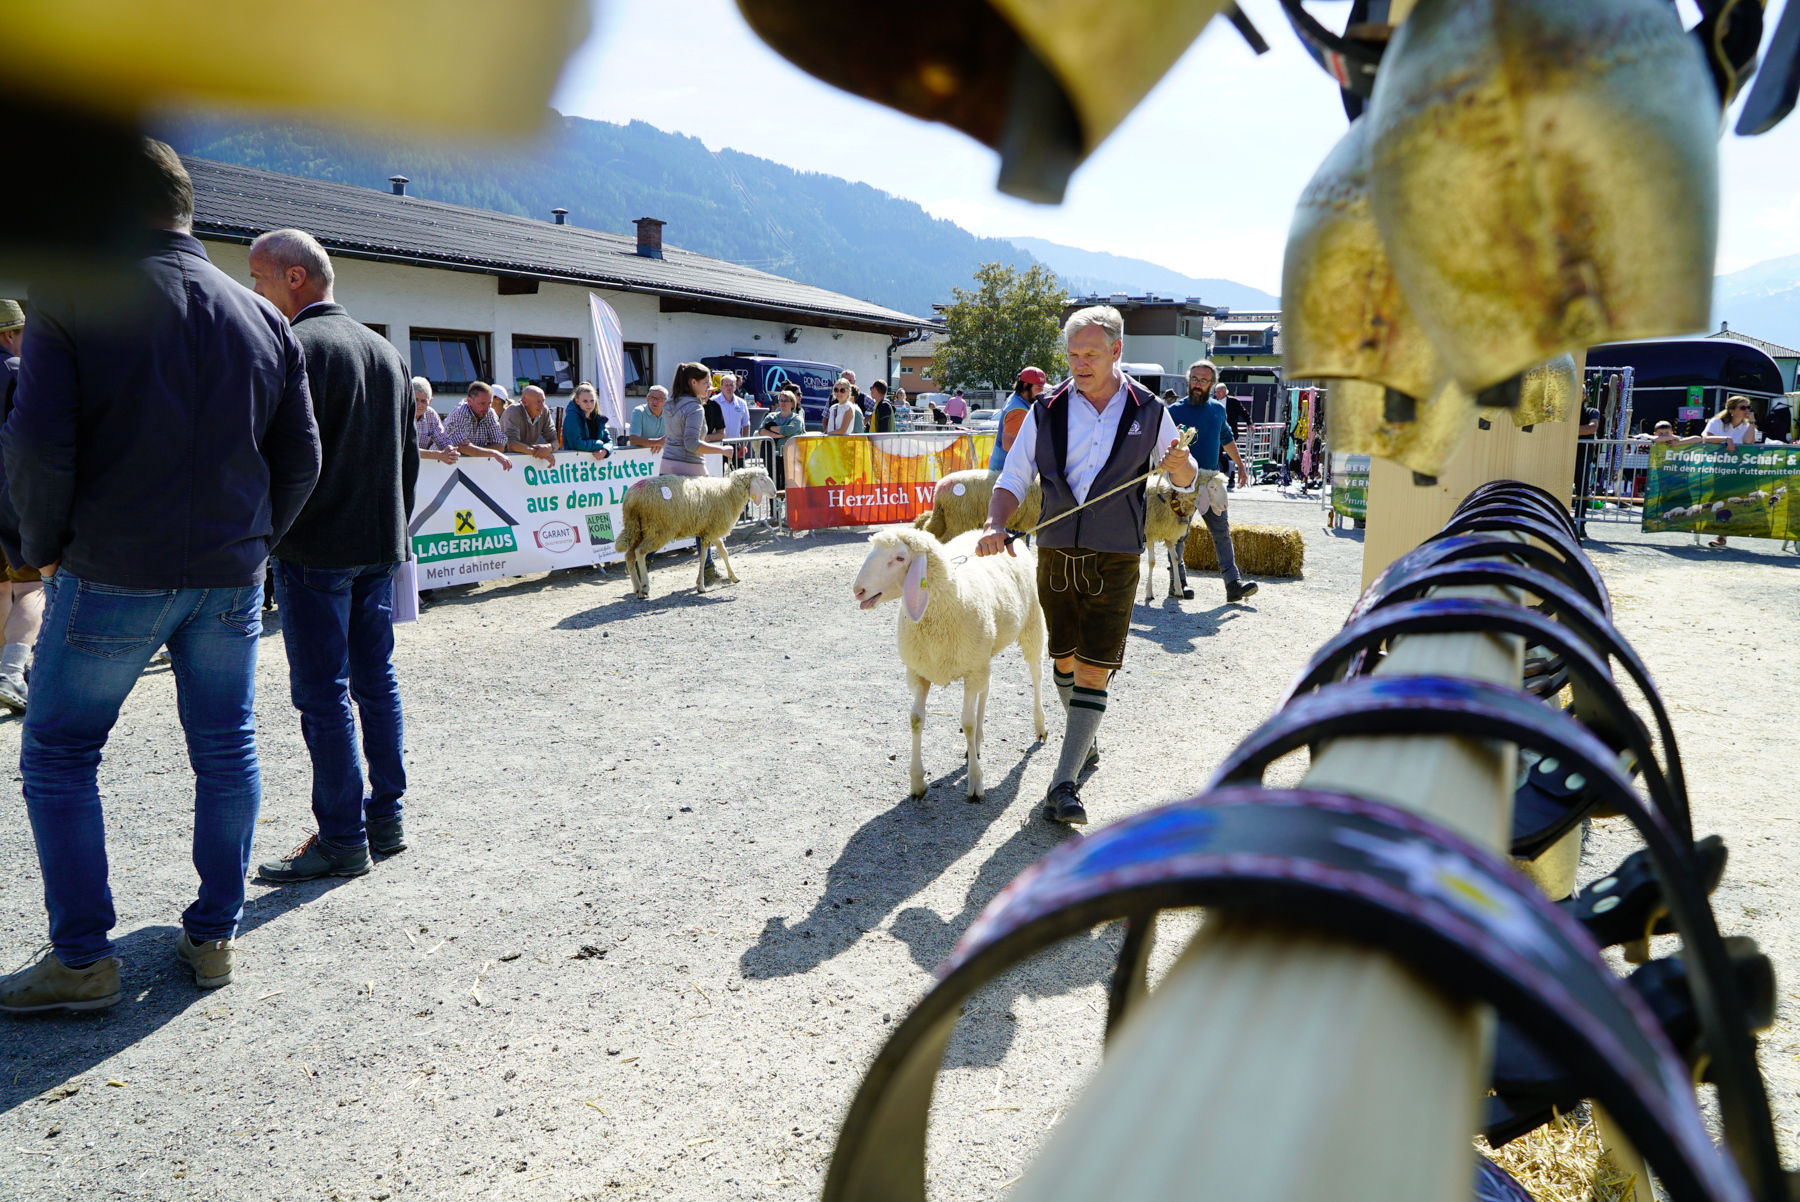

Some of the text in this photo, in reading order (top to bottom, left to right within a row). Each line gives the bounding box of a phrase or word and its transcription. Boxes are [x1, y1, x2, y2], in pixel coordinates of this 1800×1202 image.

[1665, 449, 1797, 465] Erfolgreiche Schaf- &
[524, 459, 655, 486] Qualitätsfutter
[1663, 464, 1800, 475] mit den richtigen Futtermitteln
[527, 495, 558, 513] aus
[566, 489, 603, 509] dem
[828, 487, 910, 508] Herzlich
[914, 486, 935, 504] W
[586, 515, 609, 525] ALPEN
[588, 523, 612, 534] KORN
[543, 528, 570, 539] GARANT
[417, 532, 514, 558] LAGERHAUS
[426, 559, 507, 580] Mehr dahinter
